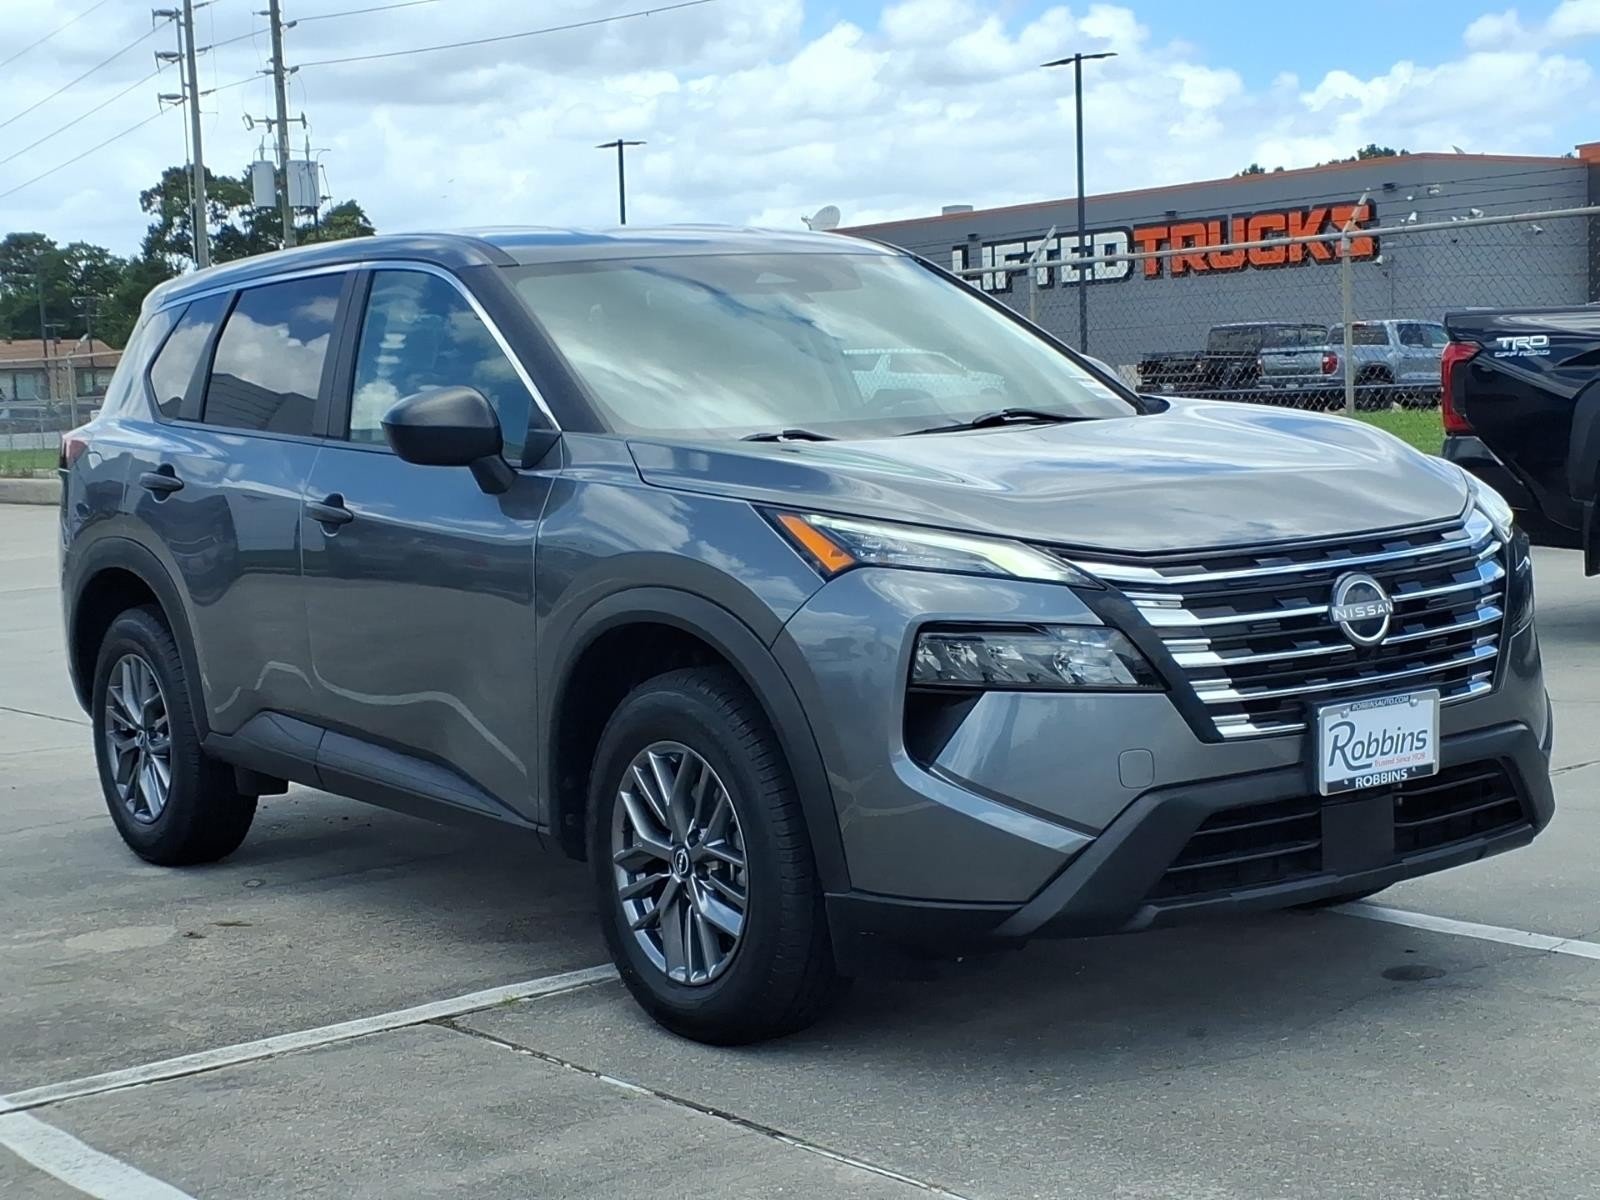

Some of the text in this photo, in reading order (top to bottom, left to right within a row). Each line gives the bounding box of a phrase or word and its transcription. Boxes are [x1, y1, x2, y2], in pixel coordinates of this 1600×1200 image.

[952, 202, 1377, 292] LIFTED TRUCKS
[1496, 334, 1549, 350] TRD
[1333, 601, 1393, 620] NISSAN
[1351, 695, 1410, 711] ROBBINSAUTO.COM
[1328, 720, 1428, 771] Robbins
[1355, 768, 1408, 789] ROBBINS
